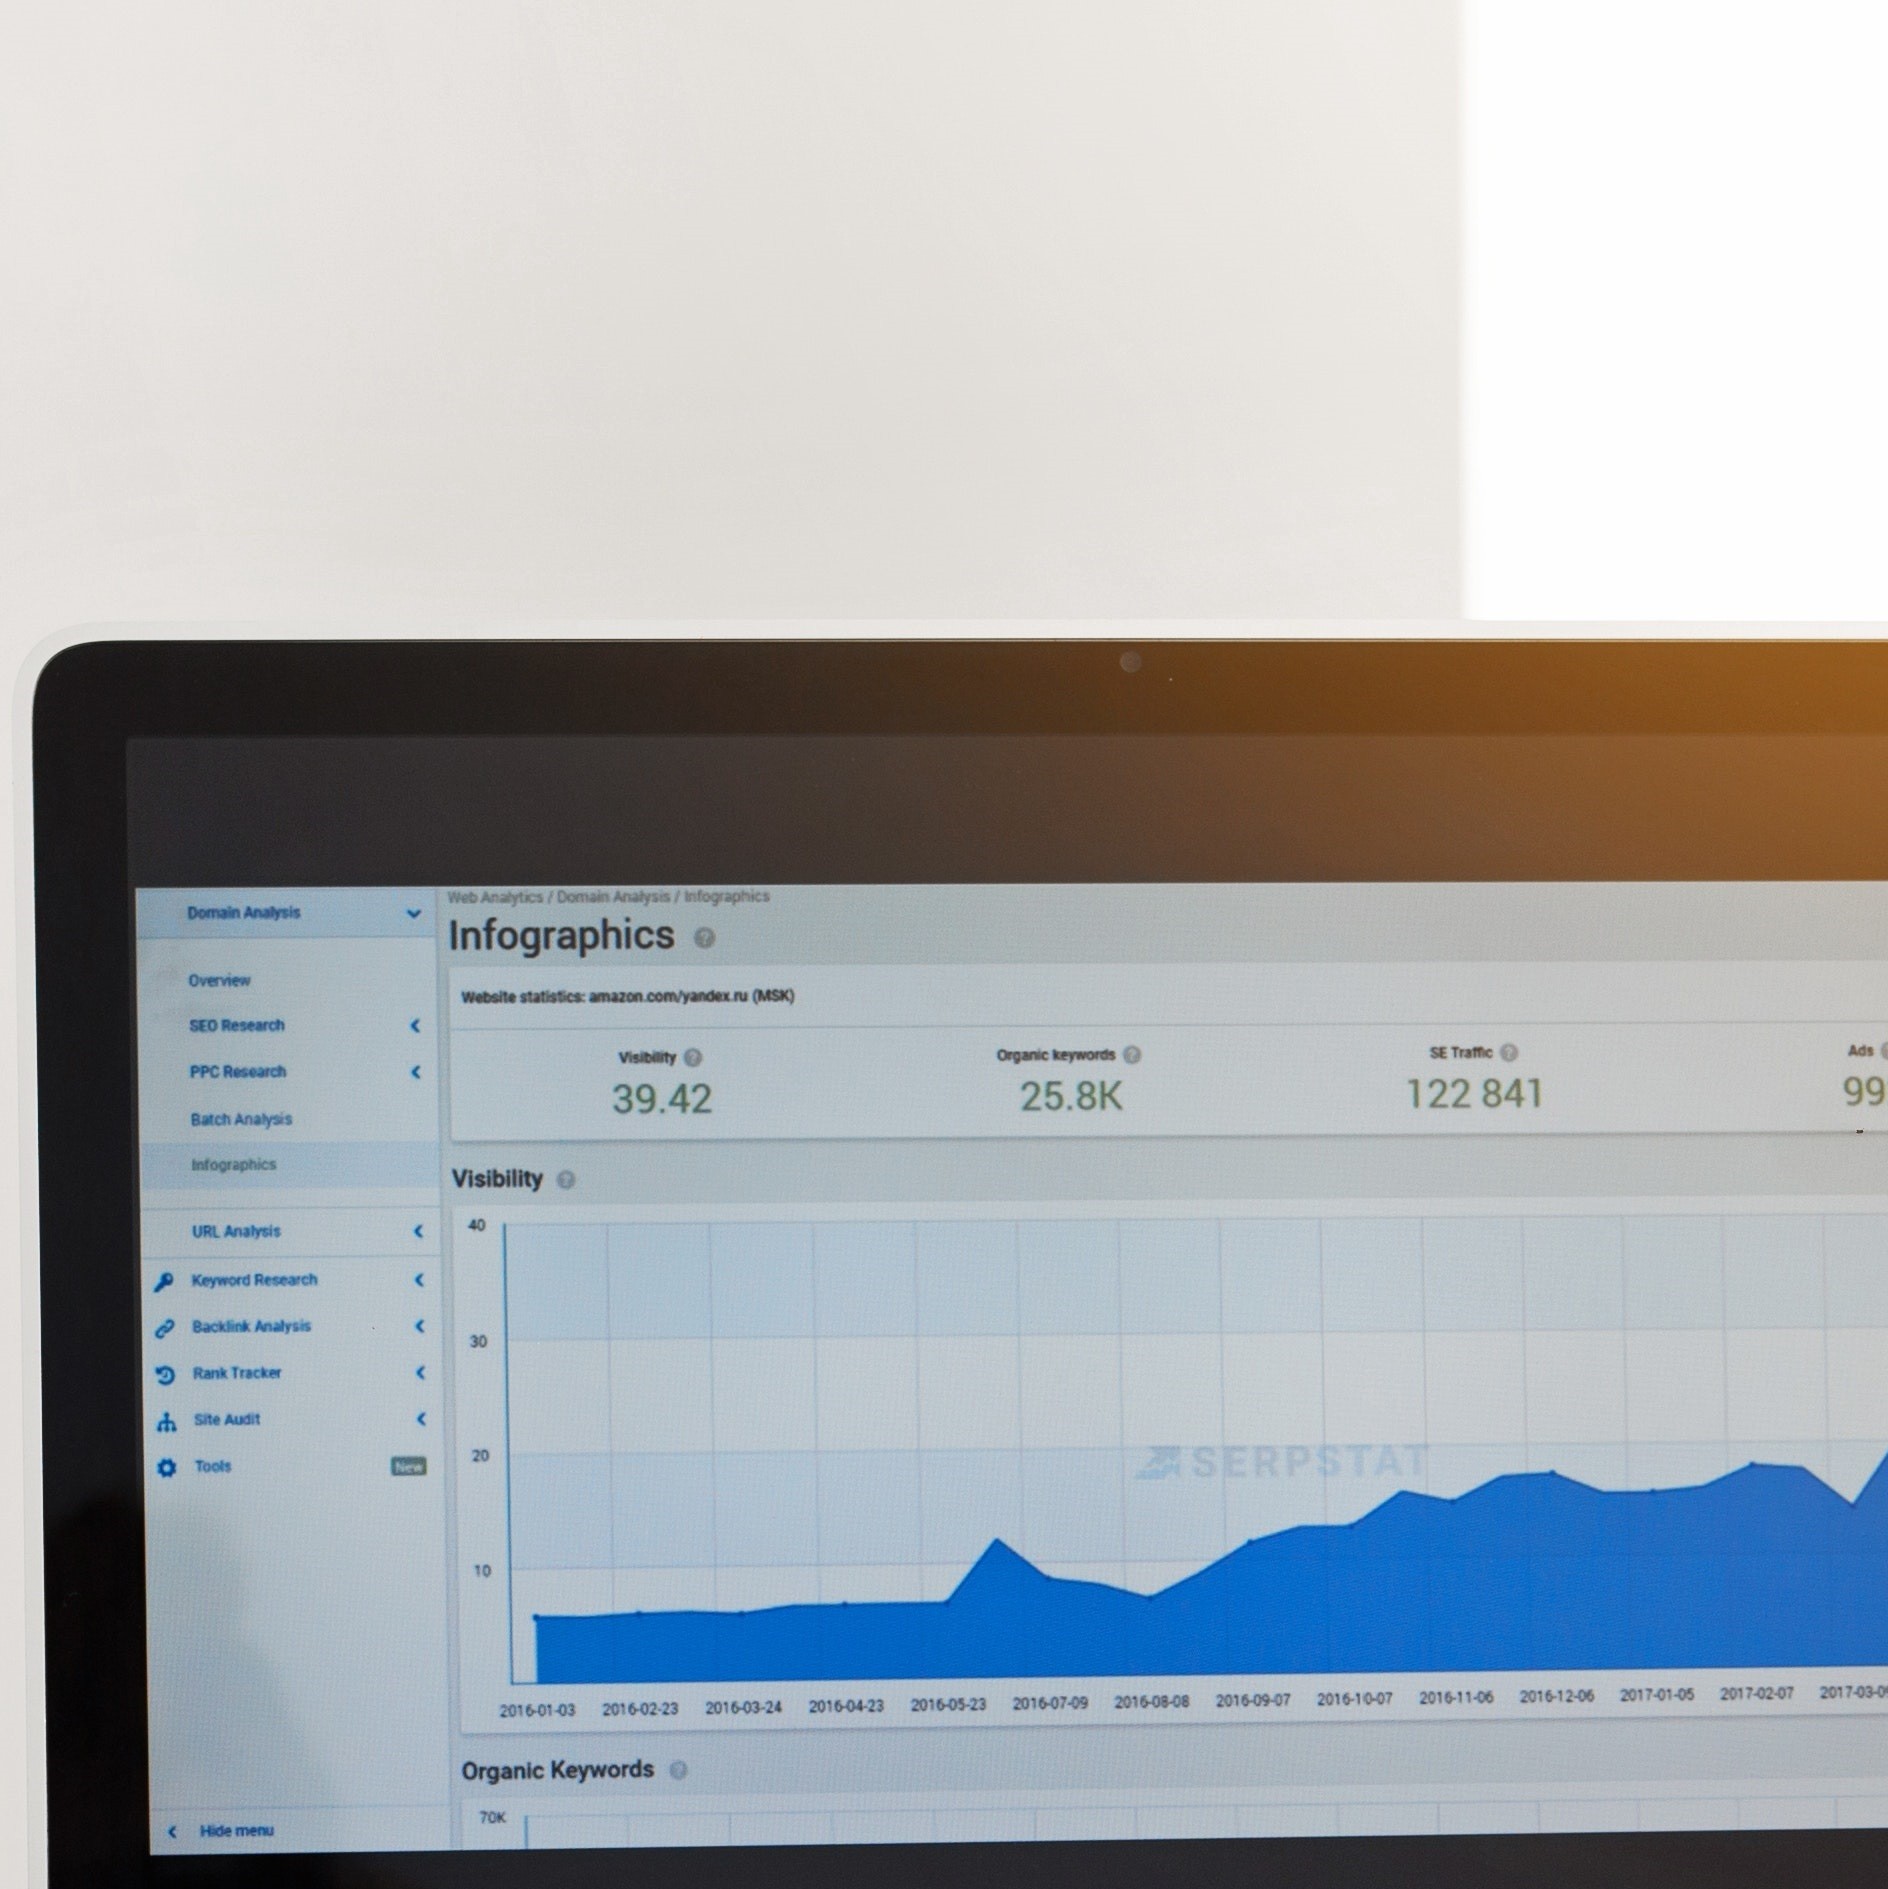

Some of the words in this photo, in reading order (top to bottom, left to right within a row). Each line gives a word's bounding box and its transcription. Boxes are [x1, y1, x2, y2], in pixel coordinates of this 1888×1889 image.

[448, 890, 477, 904] Web
[480, 889, 544, 907] Analytics
[557, 890, 610, 904] Domain
[614, 889, 672, 906] Analysis
[684, 888, 771, 905] Infographics
[188, 905, 240, 920] Domain
[244, 905, 301, 921] Analysis
[450, 917, 675, 958] Infographics
[188, 974, 251, 988] Overview
[462, 991, 516, 1004] Website
[519, 990, 586, 1004] statistics:
[589, 989, 748, 1005] amazon.com/yandex.ru
[752, 988, 795, 1005] (MSK)
[189, 1019, 218, 1033] SEO
[221, 1018, 285, 1033] Research
[997, 1048, 1049, 1063] Organic
[1052, 1049, 1116, 1063] keywords
[1430, 1046, 1448, 1059] SE
[1451, 1046, 1494, 1059] Traffic
[1847, 1044, 1874, 1057] Ads
[618, 1051, 677, 1067] Visibility
[190, 1065, 219, 1079] PPC
[223, 1064, 287, 1079] Research
[613, 1083, 712, 1114] 39.42
[1021, 1080, 1123, 1111] 25.8K
[1408, 1078, 1471, 1109] 122
[1482, 1077, 1541, 1108] 841
[191, 1112, 231, 1127] Batch
[235, 1111, 293, 1128] Analysis
[191, 1157, 277, 1173] Infographics
[452, 1168, 544, 1193] Visibility
[192, 1225, 220, 1239] URL
[224, 1224, 281, 1240] Analysis
[468, 1219, 486, 1232] 40
[192, 1273, 250, 1289] Keyword
[254, 1272, 318, 1287] Research
[192, 1320, 250, 1334] Backlink
[254, 1319, 312, 1336] Analysis
[470, 1335, 487, 1348] 30
[193, 1366, 228, 1380] Rank
[231, 1366, 282, 1380] Tracker
[194, 1412, 221, 1426] Site
[224, 1412, 261, 1426] Audit
[472, 1449, 490, 1462] 20
[1193, 1444, 1428, 1478] SERPSTAT
[195, 1460, 232, 1473] Tools
[474, 1564, 492, 1578] 10
[500, 1704, 576, 1718] 2016-01-03
[602, 1703, 679, 1716] 2016-02-23
[706, 1701, 782, 1714] 2016-03-24
[809, 1699, 884, 1713] 2016-04-23
[1013, 1696, 1088, 1710] 2016-07-09
[1216, 1693, 1291, 1707] 2016-09-07
[1317, 1692, 1393, 1706] 2016-10-07
[1420, 1691, 1494, 1704] 2016-11-06
[1520, 1690, 1595, 1703] 2016-12-06
[1620, 1688, 1695, 1702] 2017-01-05
[1720, 1687, 1794, 1700] 2017-02-07
[462, 1762, 544, 1785] Organic
[551, 1759, 655, 1783] Keywords
[480, 1811, 506, 1824] 70K
[200, 1824, 232, 1837] Hide
[235, 1826, 274, 1837] menu
